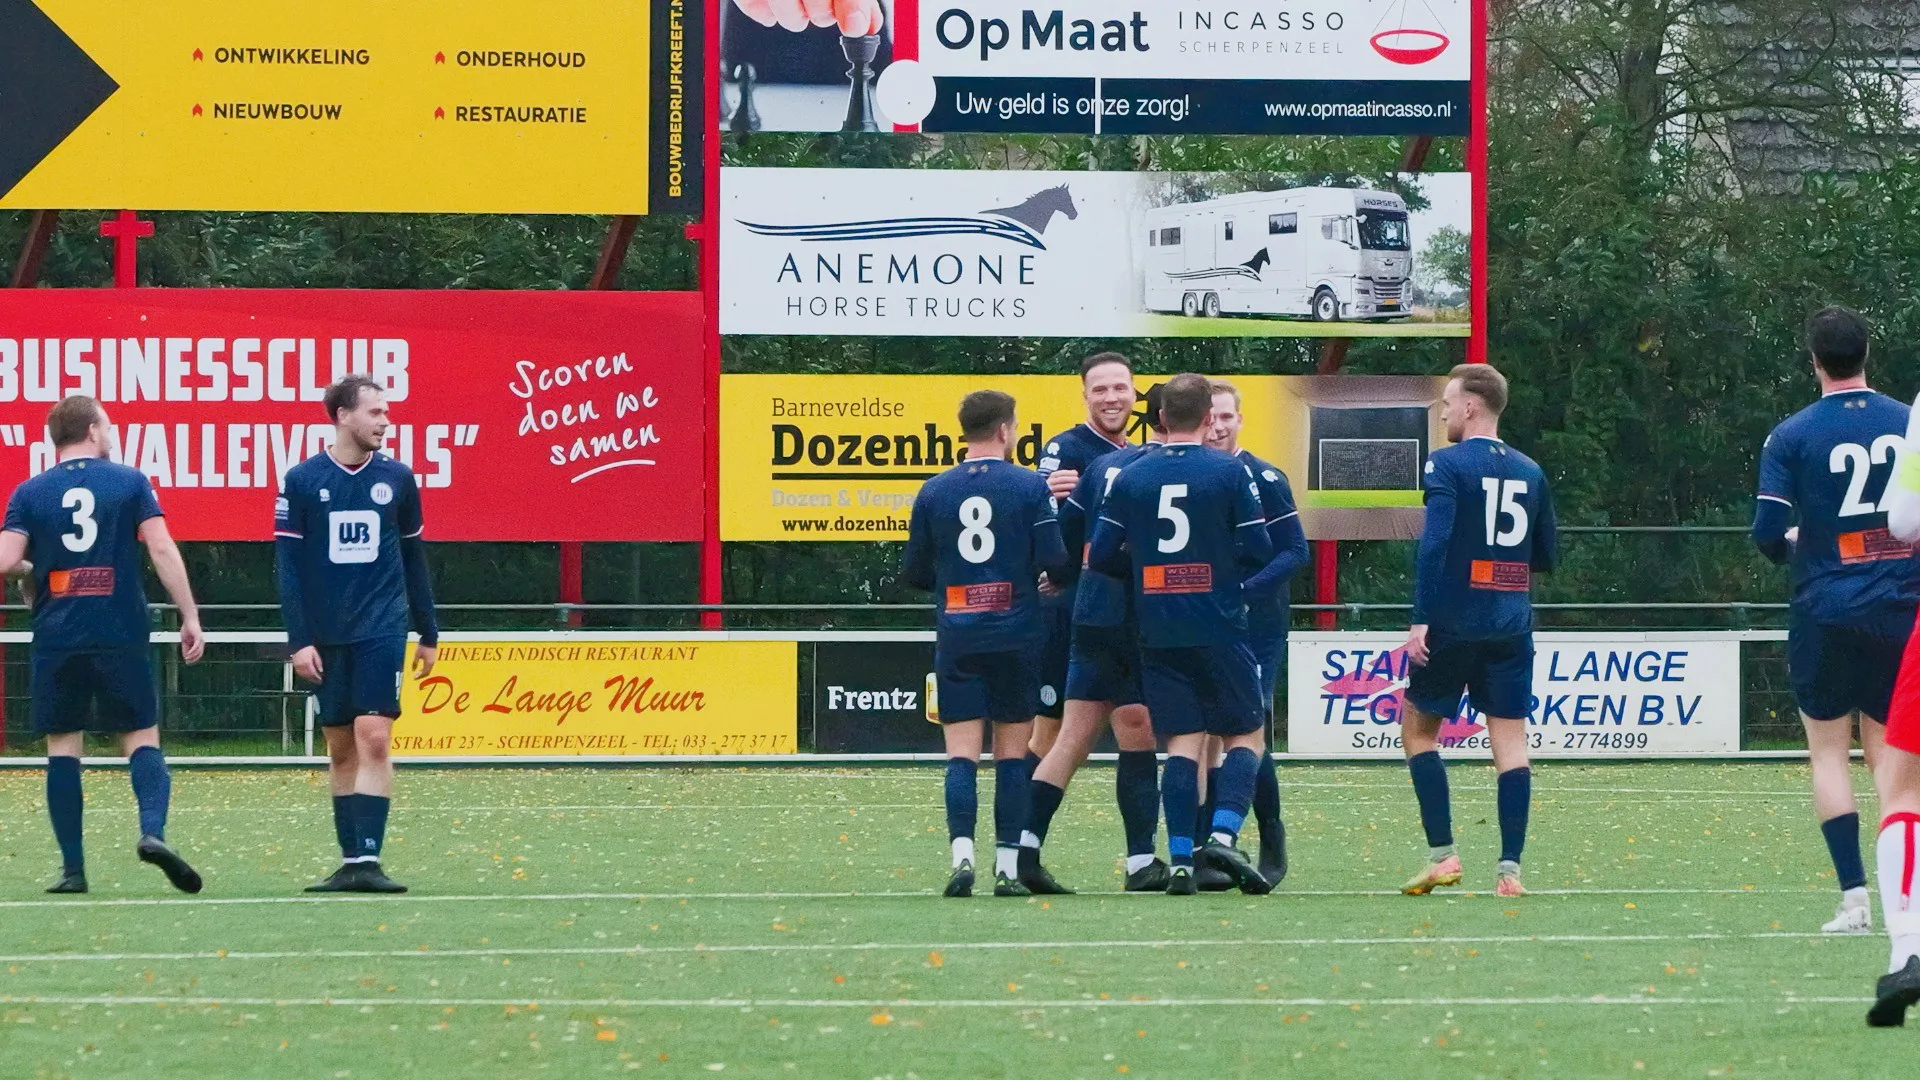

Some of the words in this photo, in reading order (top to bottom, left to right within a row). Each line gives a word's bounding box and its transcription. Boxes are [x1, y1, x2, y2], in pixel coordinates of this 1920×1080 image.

[1178, 11, 1344, 31] INCASSO
[936, 9, 1010, 60] Op
[1022, 11, 1151, 51] Maat
[214, 47, 370, 66] ONTWIKKELING
[1179, 41, 1343, 54] SCHERPENZEEL
[456, 50, 586, 68] ONDERHOUD
[214, 103, 342, 121] NIEUWBOUW
[455, 105, 586, 124] RESTAURATIE
[956, 92, 992, 114] Uw
[998, 92, 1044, 120] geld
[1052, 93, 1069, 115] is
[1075, 97, 1130, 117] onze
[1136, 93, 1190, 121] zorg!
[1265, 100, 1452, 121] www.opmaatincasso.nl
[1363, 199, 1398, 208] HORSES
[777, 252, 1035, 285] ANEMONE
[787, 296, 886, 317] HORSE
[906, 298, 1026, 318] TRUCKS
[509, 352, 634, 398] Scoren
[518, 400, 600, 436] doen
[616, 386, 659, 418] we
[772, 397, 905, 418] Barneveldse
[550, 424, 661, 466] samen
[1829, 434, 1908, 517] 22
[772, 489, 832, 506] Dozen
[838, 489, 850, 506] &
[61, 487, 98, 552] 3
[1157, 484, 1191, 553] 5
[1482, 477, 1528, 546] 15
[782, 516, 912, 531] www.dozenha
[957, 496, 995, 563] 8
[508, 647, 580, 661] INDISCH
[586, 646, 699, 661] RESTAURANT
[1548, 651, 1688, 682] LANGE
[419, 675, 470, 714] De
[482, 675, 592, 726] Lange
[604, 675, 706, 714] Muur
[827, 686, 917, 710] Frentz
[459, 736, 484, 749] 237
[497, 735, 628, 749] SCHERPENZEEL
[643, 735, 677, 748] TEL:
[683, 735, 706, 748] 033
[721, 735, 745, 748] 277
[749, 735, 766, 748] 37
[771, 735, 787, 748] 17
[1564, 732, 1648, 749] 2774899
